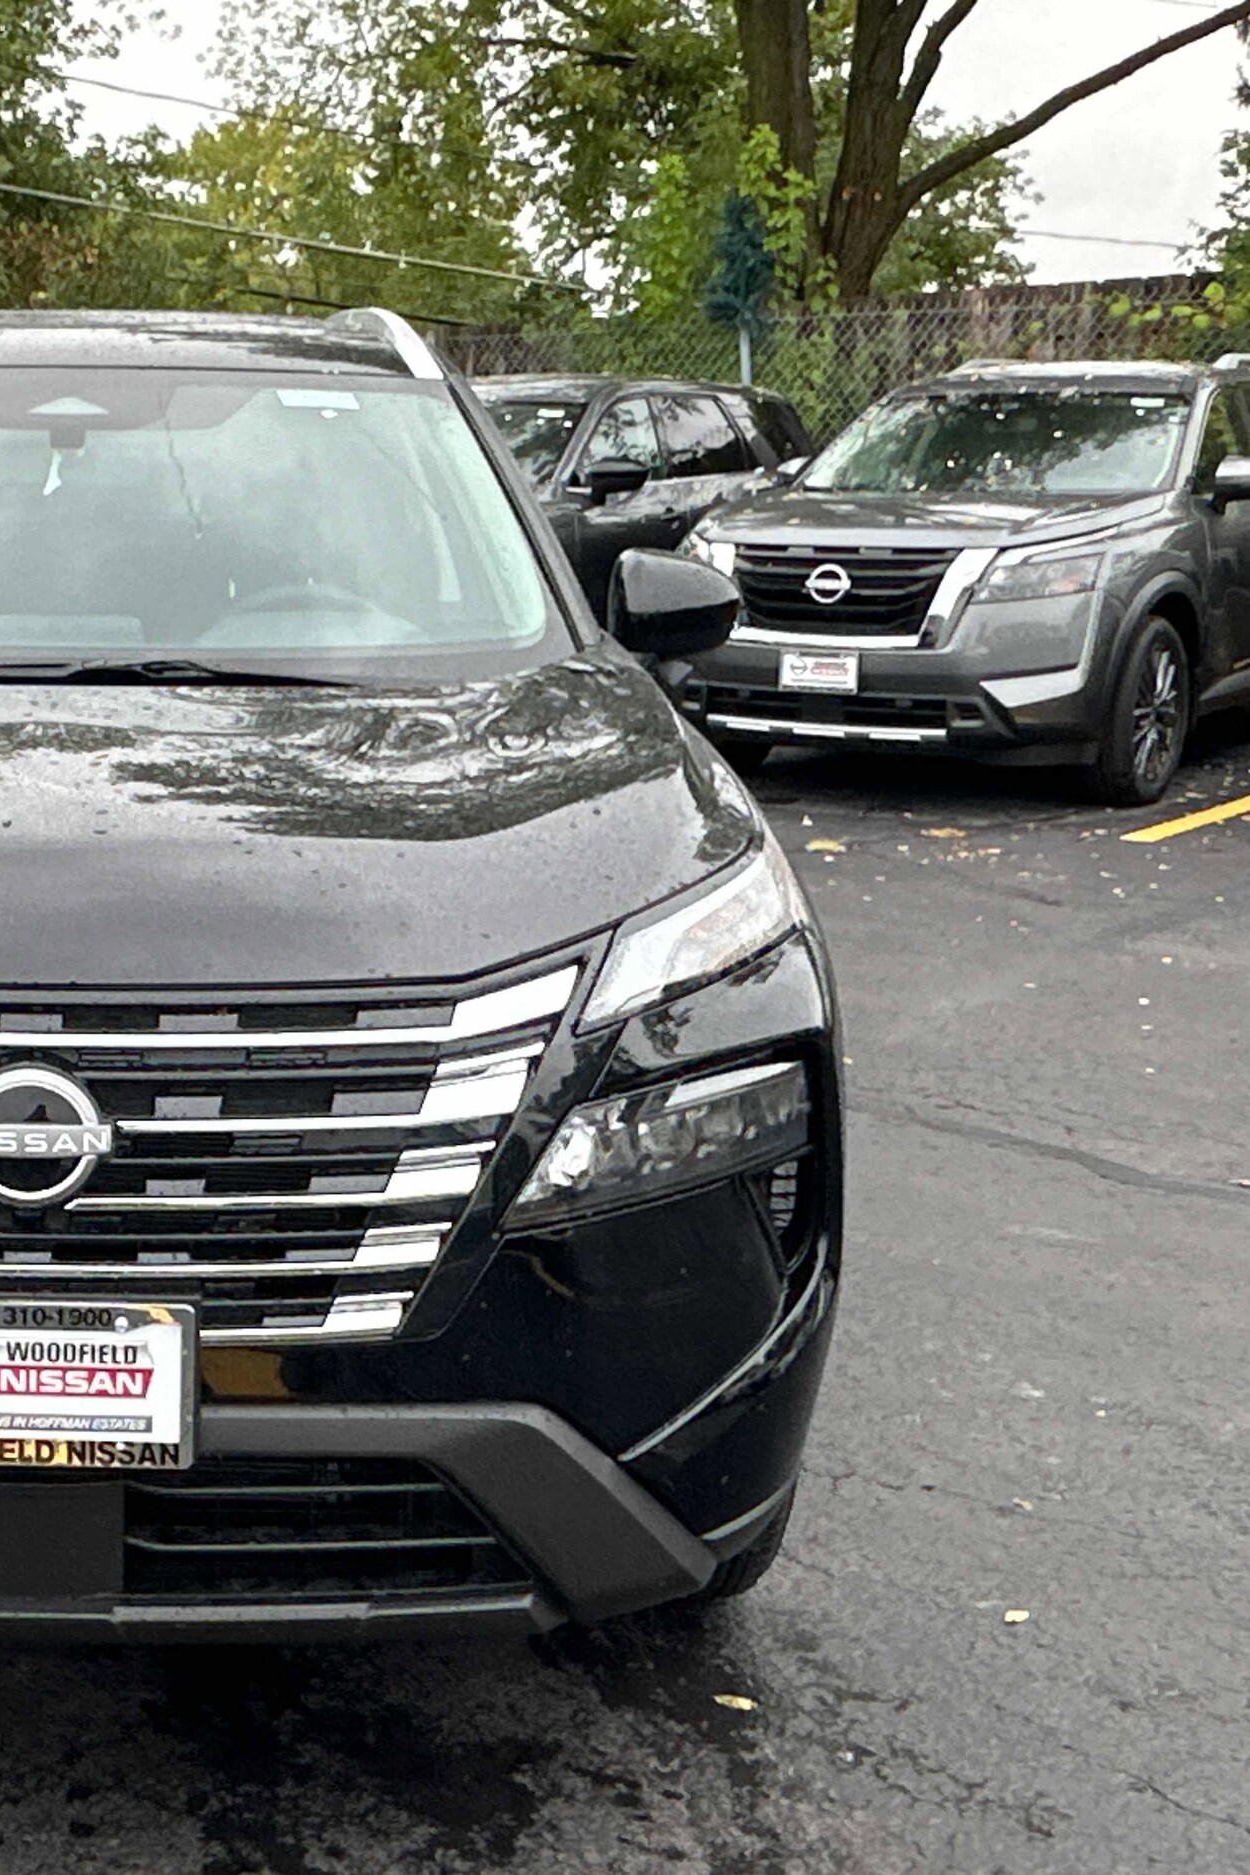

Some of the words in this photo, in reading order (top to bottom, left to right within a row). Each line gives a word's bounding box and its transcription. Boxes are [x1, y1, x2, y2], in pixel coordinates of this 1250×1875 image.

[3, 1307, 112, 1327] 310-1900
[6, 1341, 138, 1364] WOODFIELD
[0, 1367, 144, 1395] NISSAN
[91, 1418, 146, 1431] ESTATES
[67, 1442, 180, 1466] NISSAN
